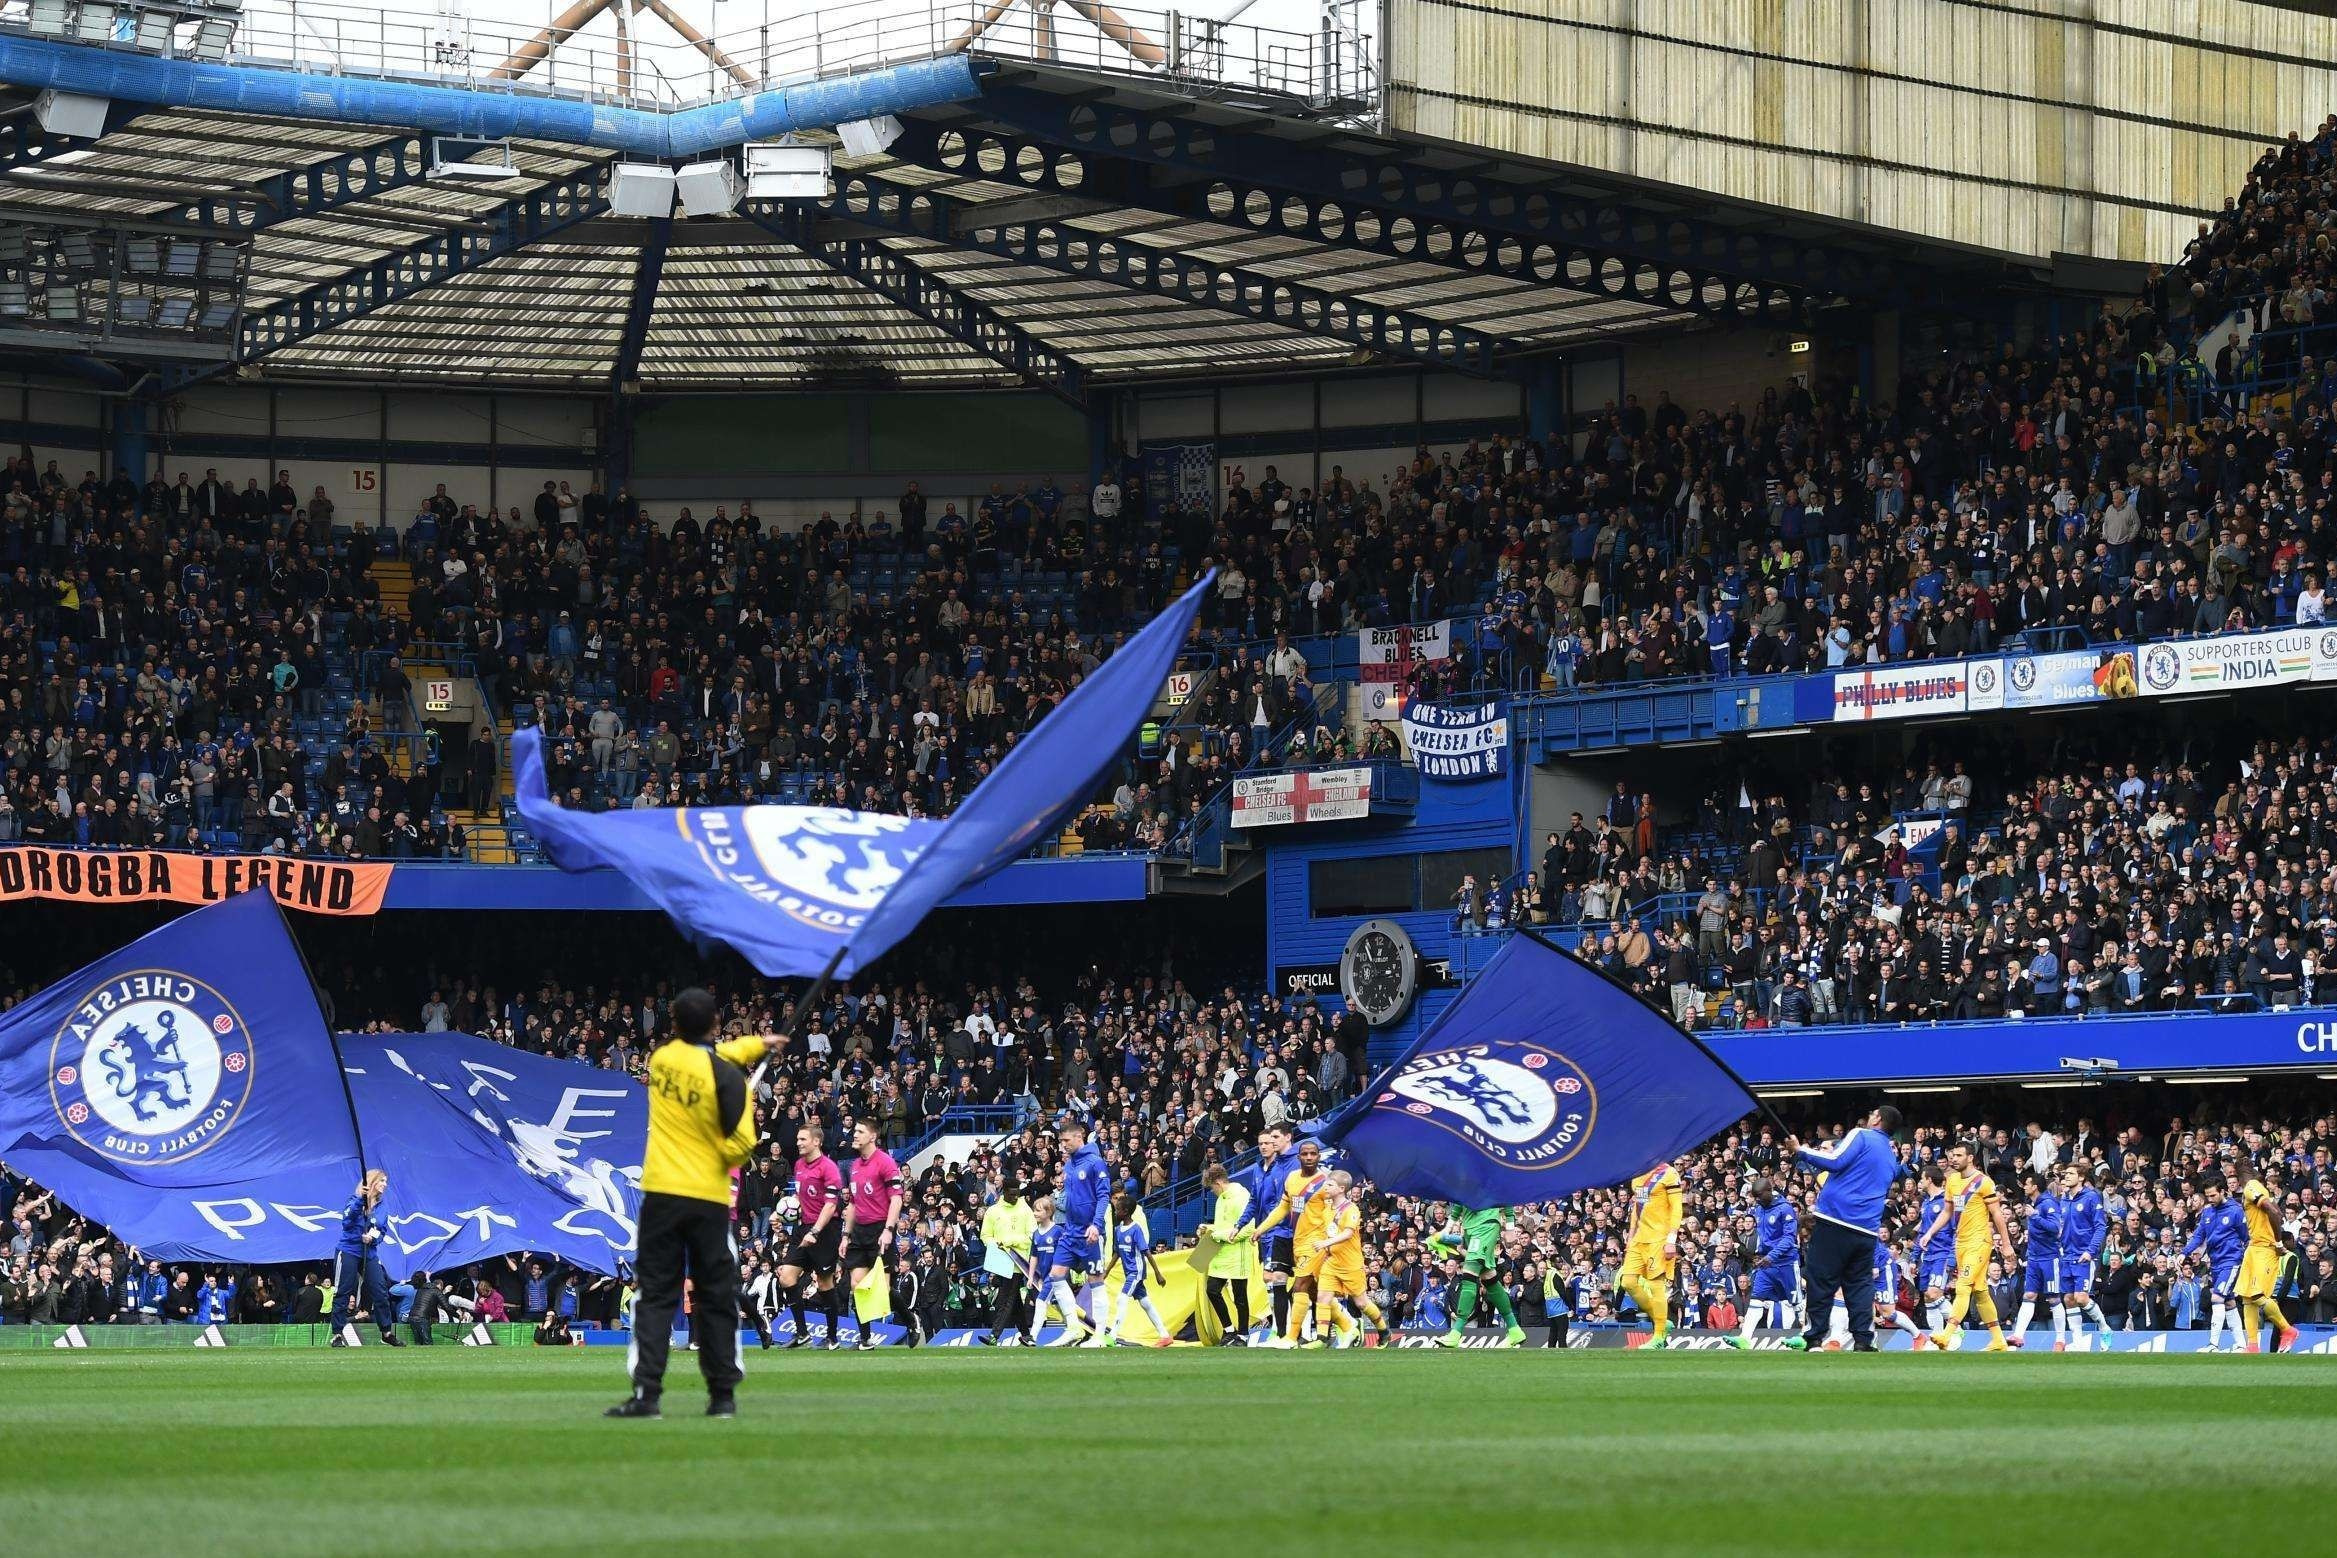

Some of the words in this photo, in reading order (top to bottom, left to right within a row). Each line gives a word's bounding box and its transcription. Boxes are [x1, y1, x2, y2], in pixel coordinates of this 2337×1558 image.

[353, 471, 375, 490] 15
[1372, 626, 1439, 645] BRACKNELL
[1558, 639, 1569, 653] 10
[2188, 641, 2272, 660] SUPPORTERS
[2276, 636, 2311, 653] CLUB
[1385, 646, 1423, 663] BLUES
[2043, 655, 2100, 672] German
[2223, 659, 2277, 681] INDIA
[1363, 665, 1408, 681] CHEL
[430, 684, 449, 699] 15
[1171, 677, 1188, 693] 16
[1842, 682, 1898, 707] PHILLY
[1905, 677, 1957, 702] BLUES
[2054, 685, 2095, 699] Blues
[1413, 704, 1437, 723] ONE
[1441, 709, 1476, 725] TEAM
[1481, 703, 1494, 721] IN
[1412, 729, 1468, 750] CHELSEA
[1476, 727, 1493, 746] FC
[1424, 755, 1480, 776] LONDON
[1252, 777, 1277, 786] Stamford
[1322, 775, 1347, 784] Wembley
[1245, 795, 1275, 809] CHELSEA
[1277, 793, 1287, 806] FC
[1325, 787, 1359, 801] ENGLAND
[1267, 811, 1292, 821] Blues
[1310, 807, 1342, 818] Wheels
[0, 851, 171, 896] DROGBA
[202, 859, 354, 910] LEGEND
[1289, 974, 1335, 988] OFFICIAL
[2298, 1022, 2337, 1052] CH
[1088, 1261, 1104, 1274] 24
[1875, 1290, 1889, 1303] 30
